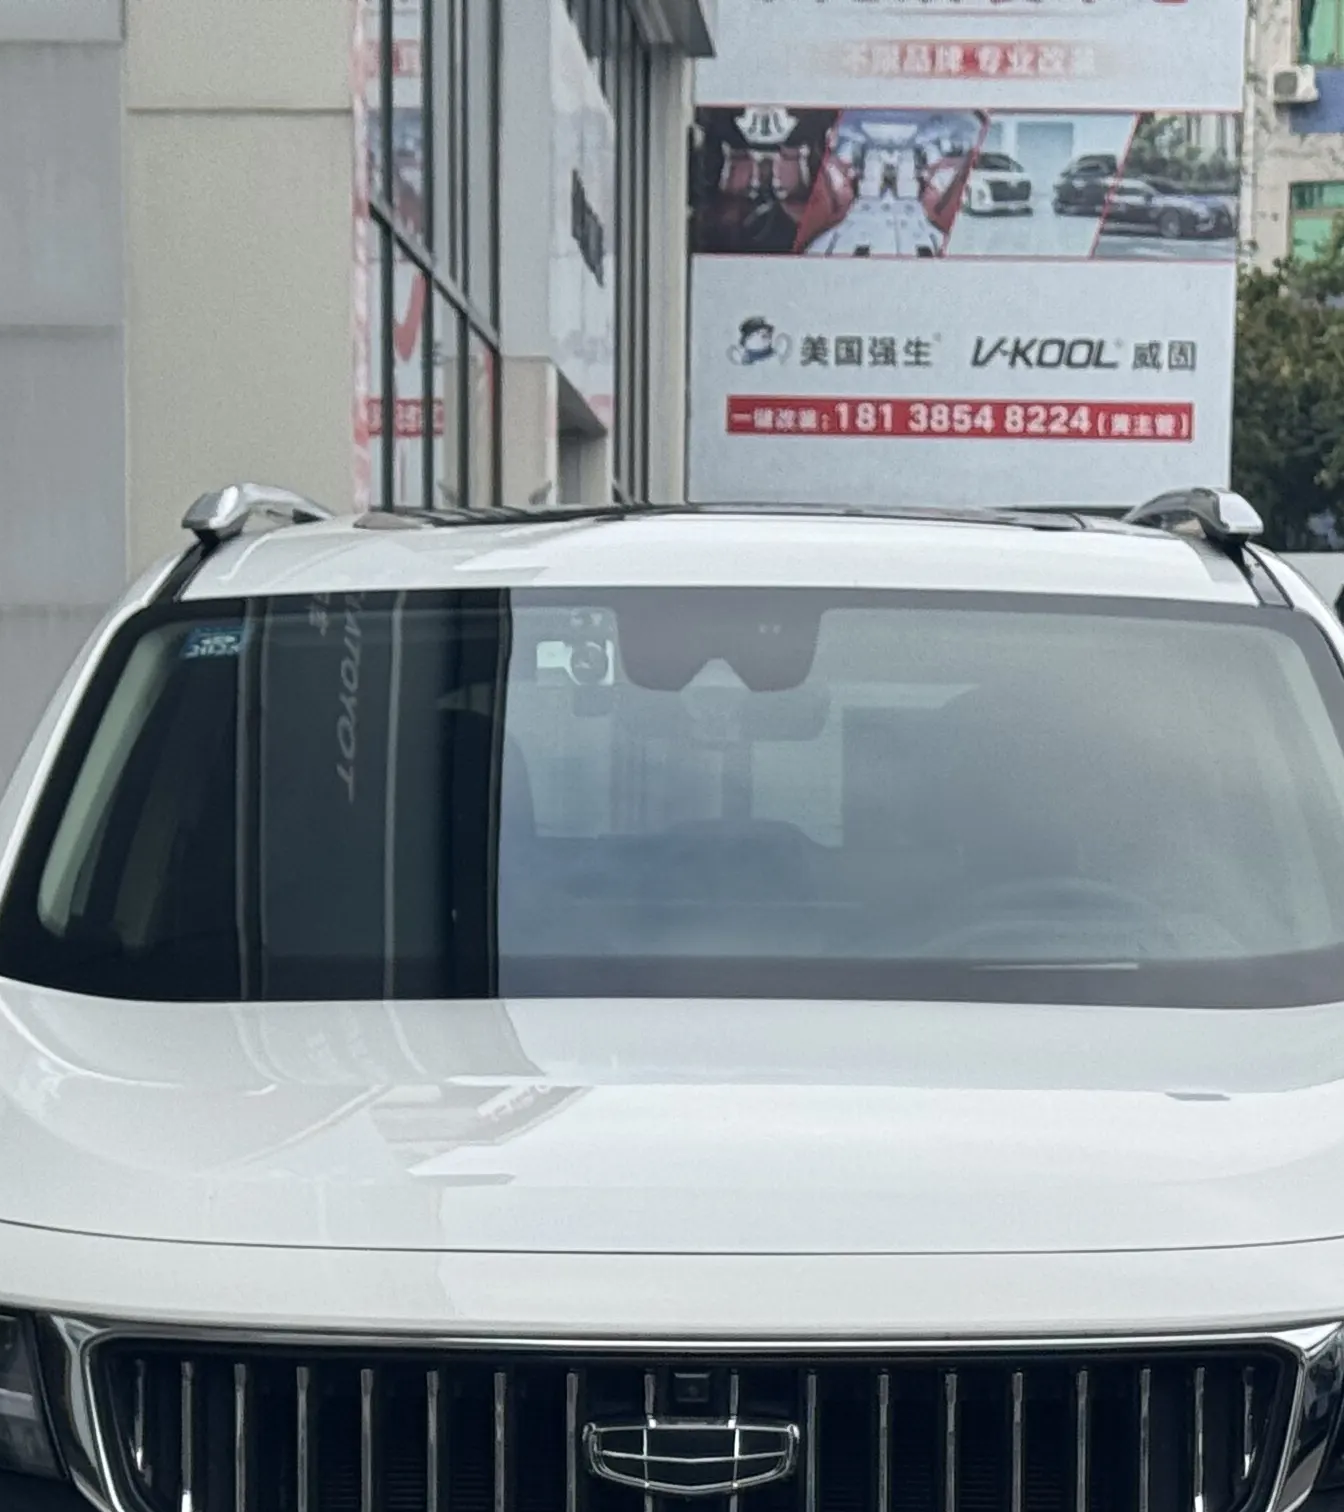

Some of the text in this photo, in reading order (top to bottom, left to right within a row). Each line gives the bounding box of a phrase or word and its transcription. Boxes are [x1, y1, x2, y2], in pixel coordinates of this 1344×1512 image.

[799, 334, 1197, 372] 美国强生 V-KOOL 威固
[835, 402, 894, 433] 181
[908, 402, 994, 434] 3854
[1005, 405, 1092, 435] 8224
